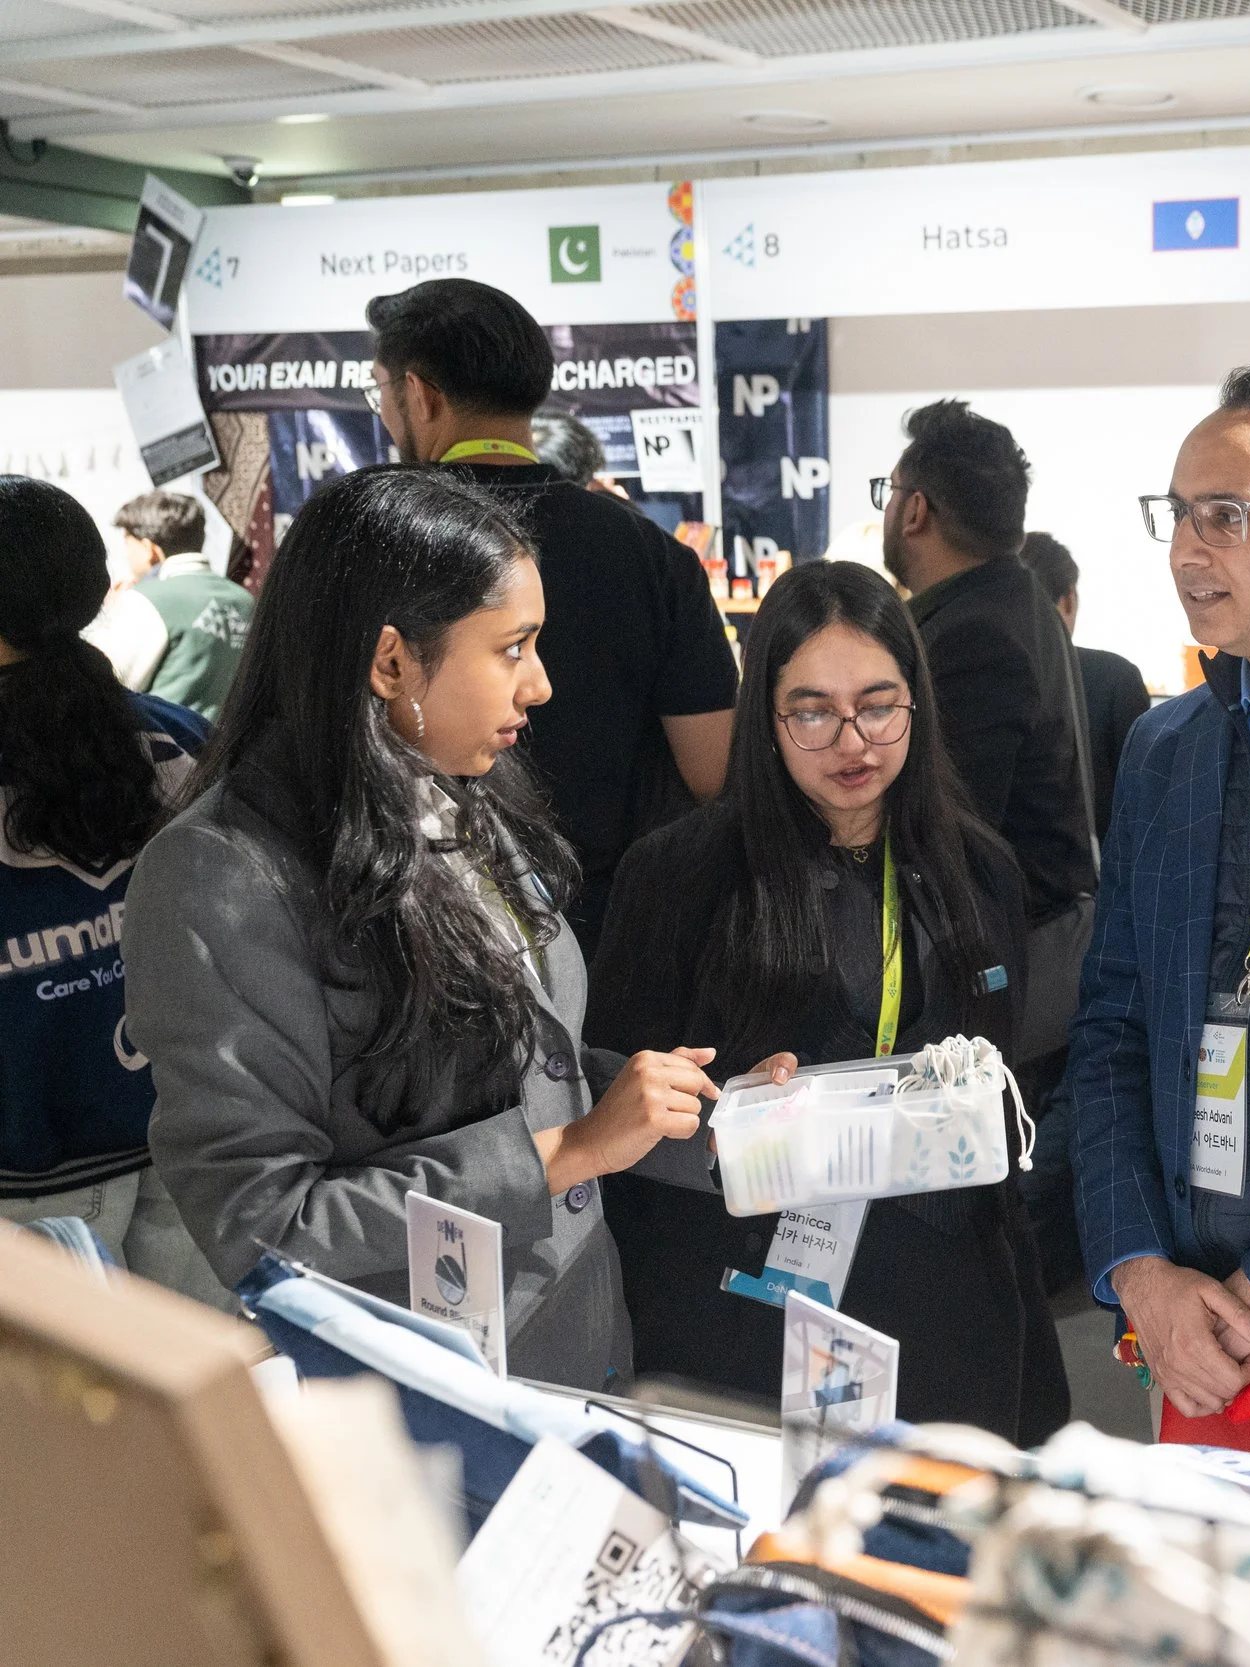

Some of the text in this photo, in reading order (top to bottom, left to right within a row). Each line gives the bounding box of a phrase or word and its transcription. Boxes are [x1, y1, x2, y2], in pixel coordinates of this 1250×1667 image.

[764, 233, 780, 257] 8
[921, 224, 1009, 250] Hatsa
[226, 256, 240, 279] 7
[320, 250, 468, 276] Next Papers
[207, 363, 267, 392] YOUR
[270, 361, 337, 390] EXAM
[733, 374, 780, 417] NP
[643, 435, 670, 457] NP
[296, 441, 337, 481] NP
[780, 456, 830, 500] NP
[36, 978, 92, 1001] Care
[1209, 1111, 1233, 1126] Advani
[1203, 1132, 1237, 1153] 아드바니
[1196, 1164, 1222, 1177] Worldwide
[802, 1234, 838, 1255] 바자지
[784, 1256, 802, 1268] India
[421, 1297, 448, 1318] Round
